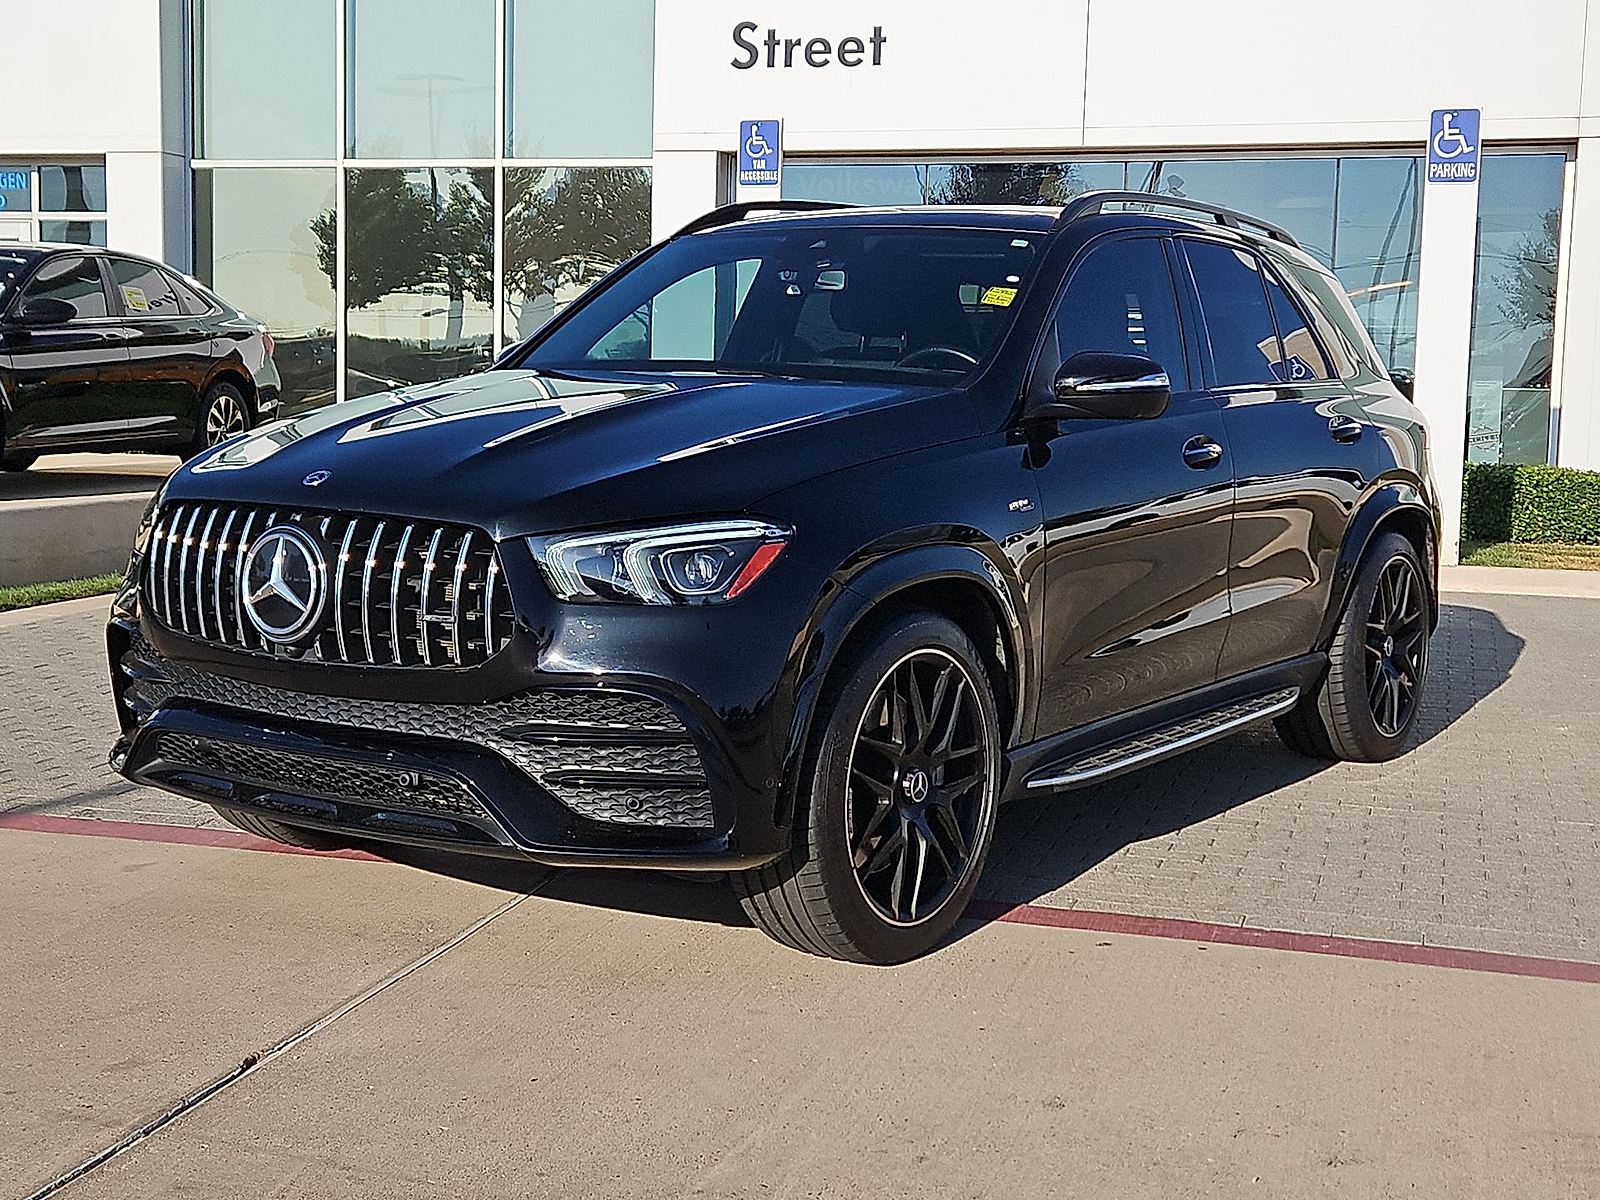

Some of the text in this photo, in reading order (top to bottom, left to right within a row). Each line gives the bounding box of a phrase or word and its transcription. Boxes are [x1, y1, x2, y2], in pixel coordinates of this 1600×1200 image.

[731, 21, 886, 69] Street
[740, 170, 777, 180] ACCESSIBLE
[1430, 162, 1475, 178] PARKING
